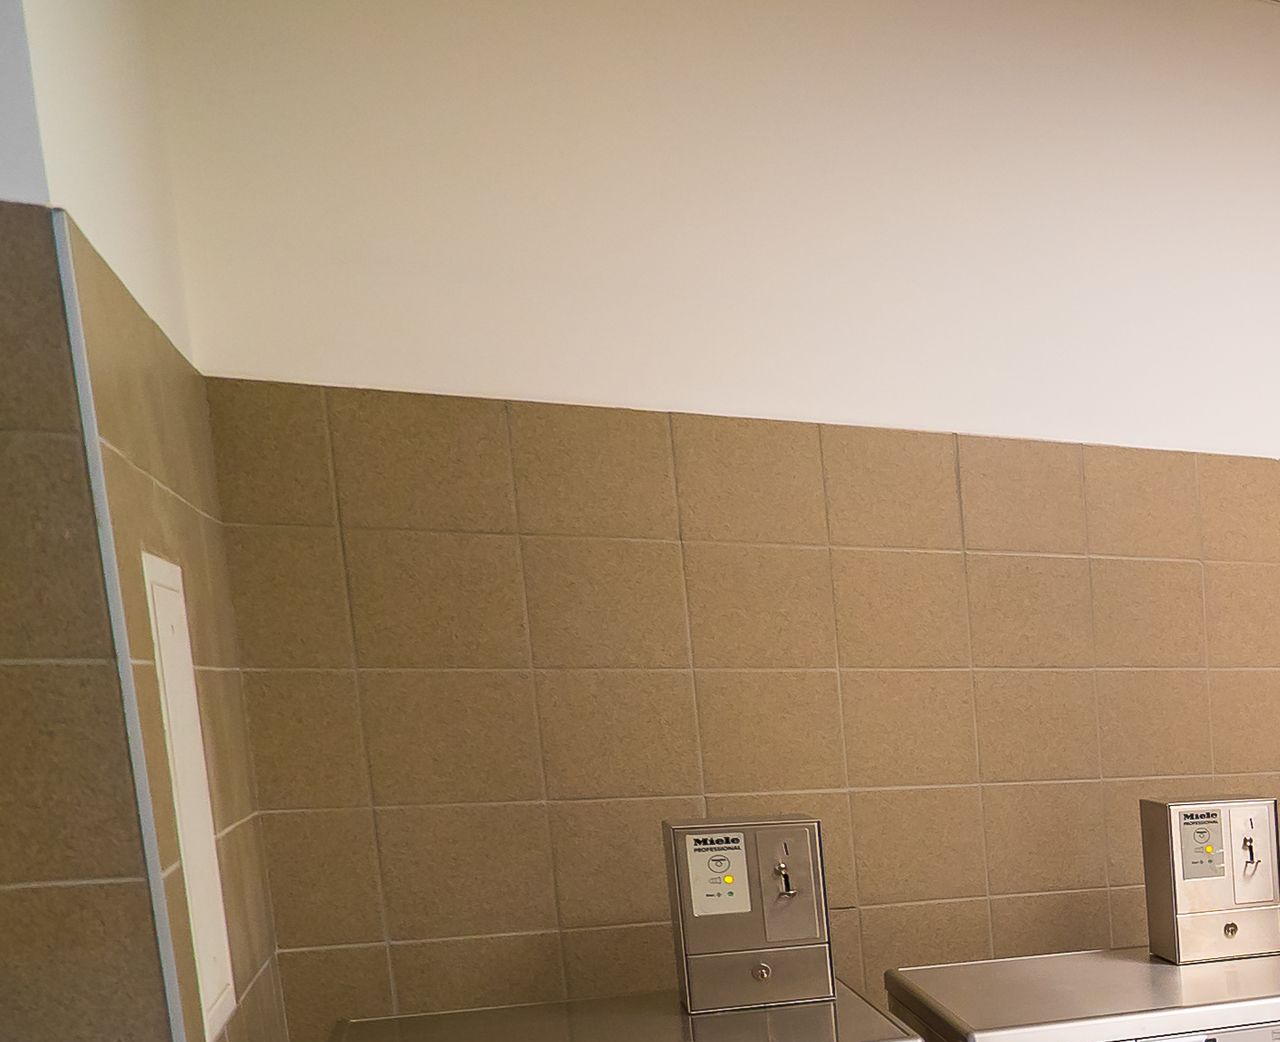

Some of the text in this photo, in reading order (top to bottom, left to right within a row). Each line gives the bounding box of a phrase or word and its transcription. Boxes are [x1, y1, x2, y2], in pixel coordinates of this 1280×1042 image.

[1183, 812, 1218, 821] Miele
[693, 837, 741, 846] Miele
[693, 845, 742, 853] PROFESSIONAL
